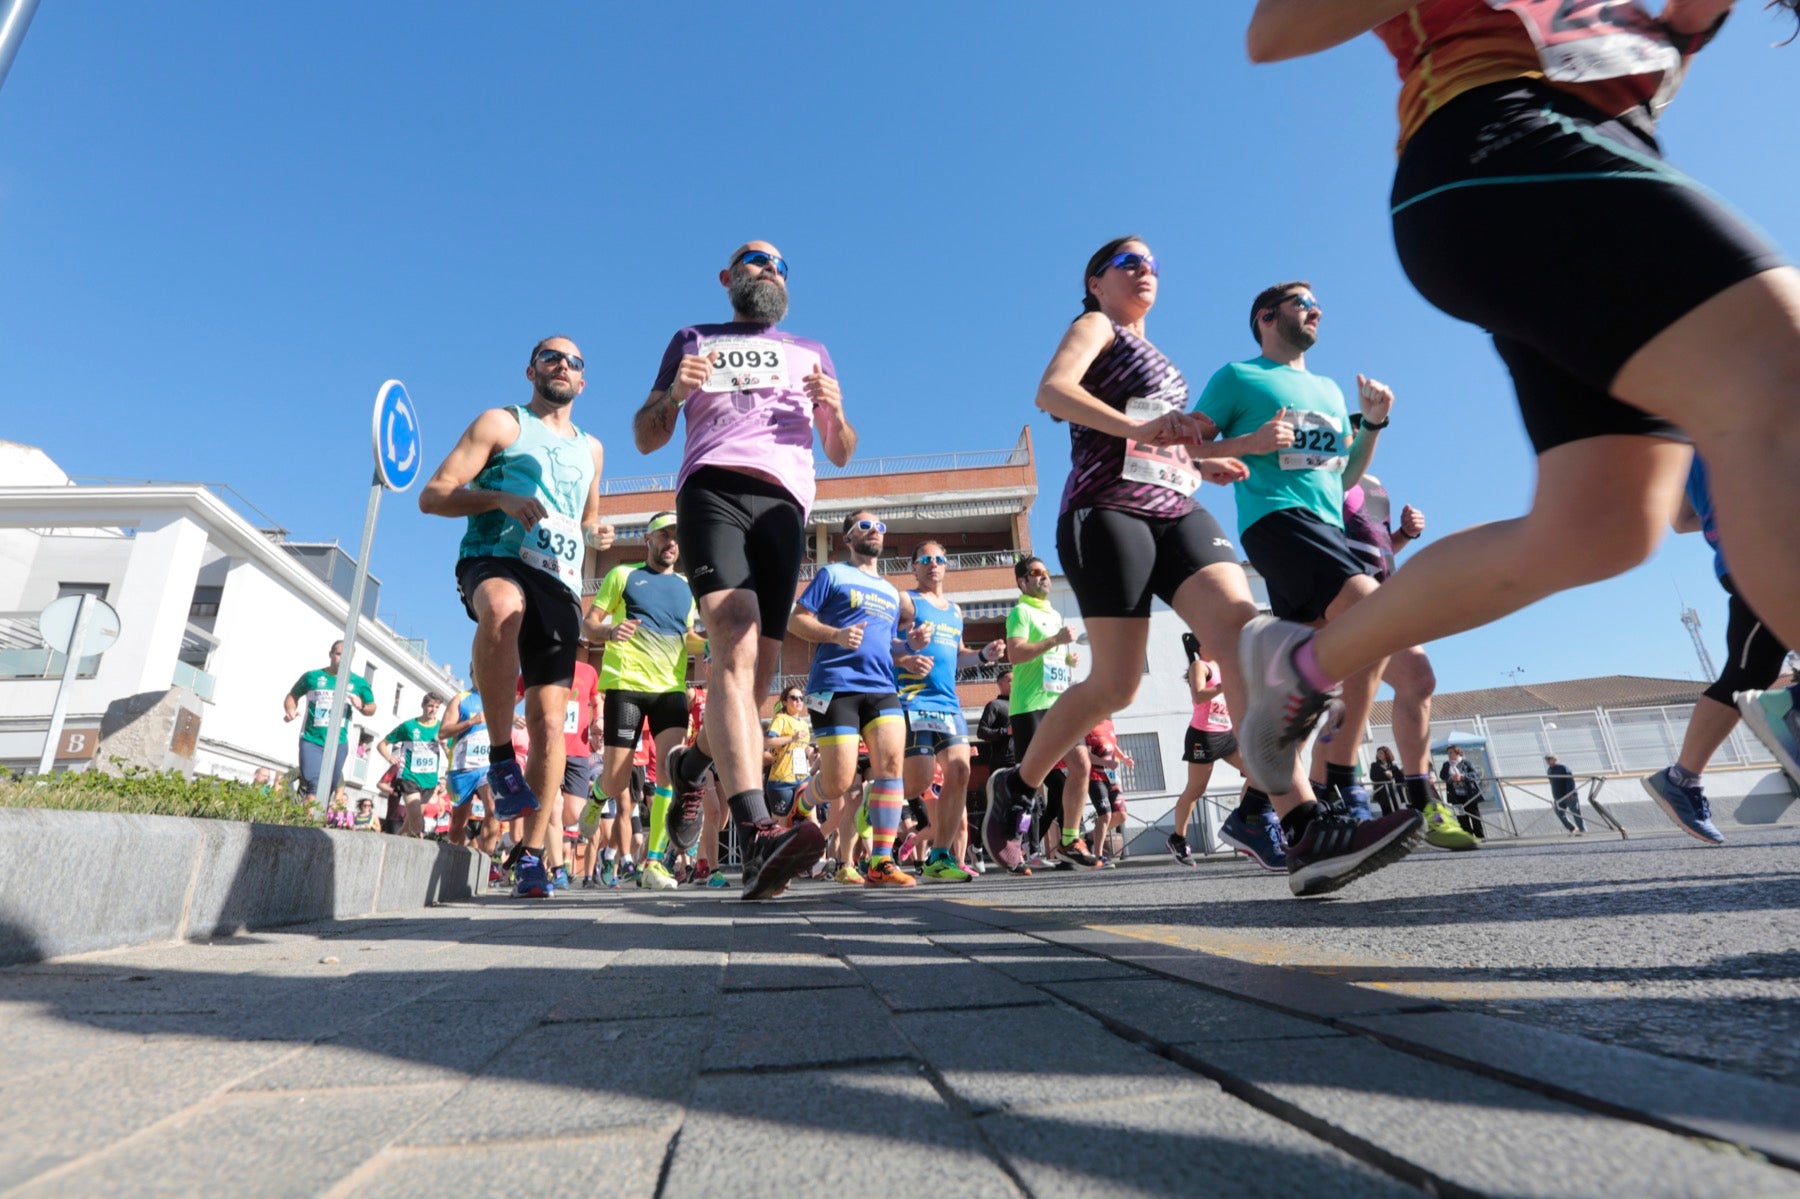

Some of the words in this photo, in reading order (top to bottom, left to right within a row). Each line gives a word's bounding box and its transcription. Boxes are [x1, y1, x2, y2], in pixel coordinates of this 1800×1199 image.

[712, 351, 779, 369] 3093
[1294, 429, 1337, 452] 922
[537, 528, 577, 561] 933
[865, 593, 896, 610] olimpo
[66, 734, 86, 753] B
[416, 758, 434, 766] 695
